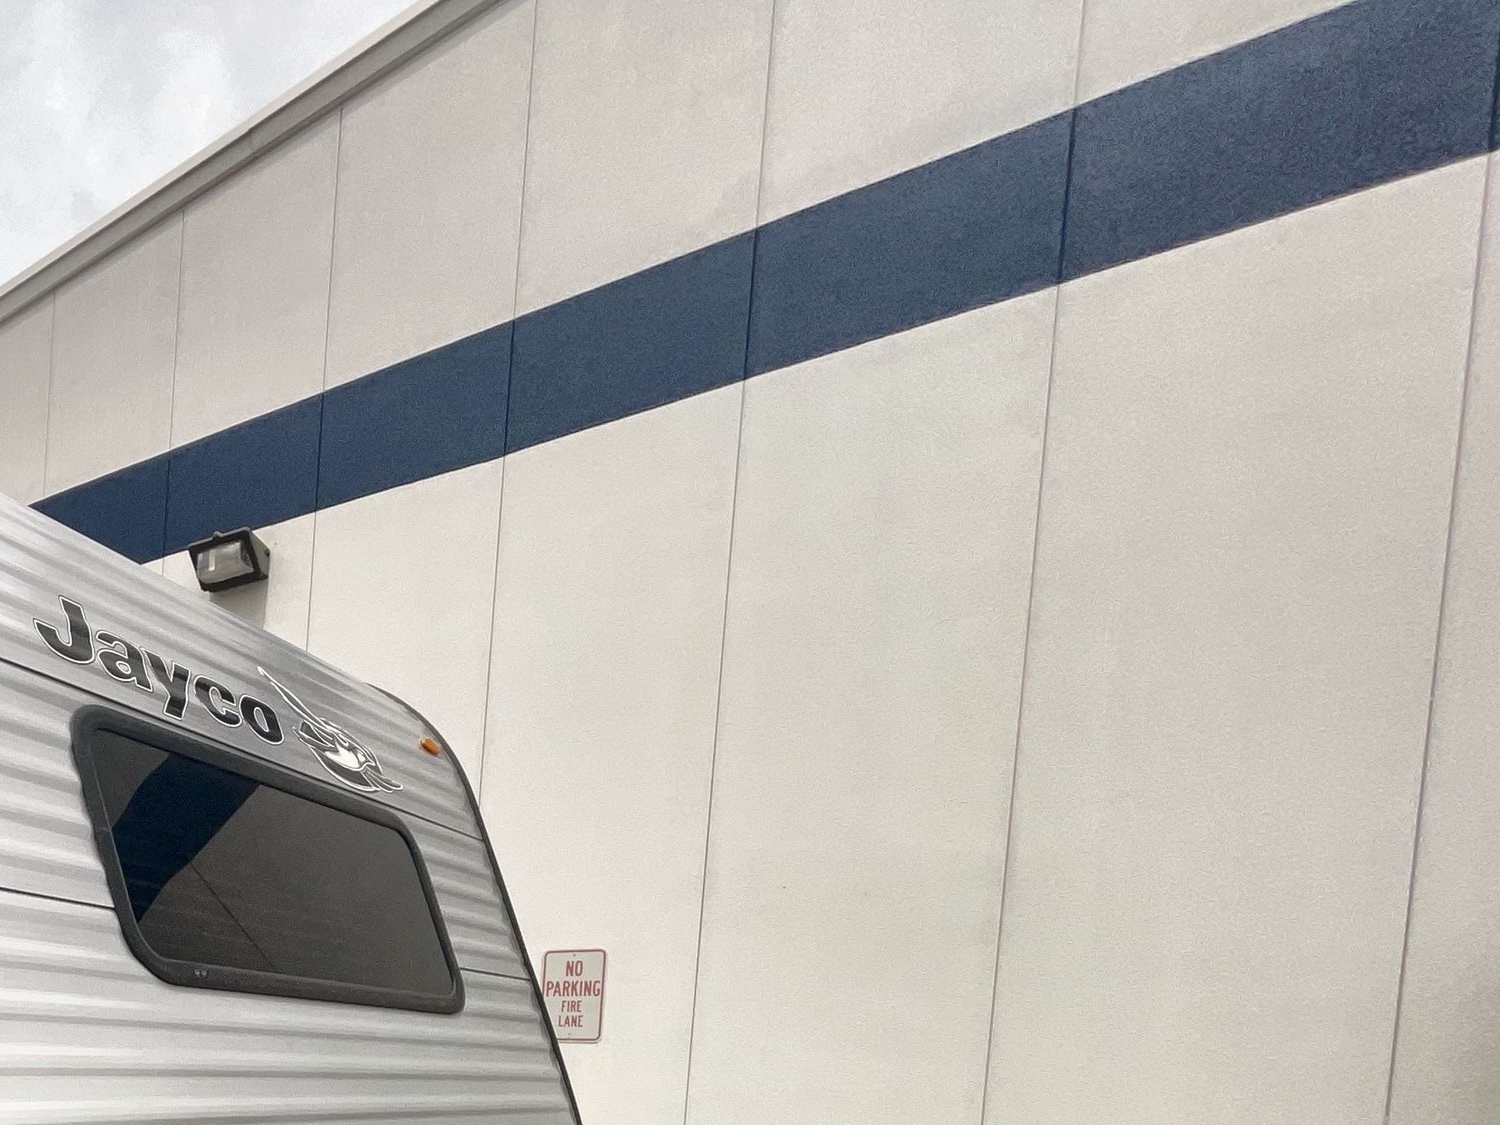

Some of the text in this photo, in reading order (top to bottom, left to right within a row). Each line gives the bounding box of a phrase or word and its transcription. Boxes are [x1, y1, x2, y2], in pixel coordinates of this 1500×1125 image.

[32, 595, 284, 745] Jayco
[565, 960, 583, 977] NO
[545, 980, 601, 997] PARKING
[561, 1000, 582, 1013] FIRE
[557, 1015, 584, 1028] LANE
